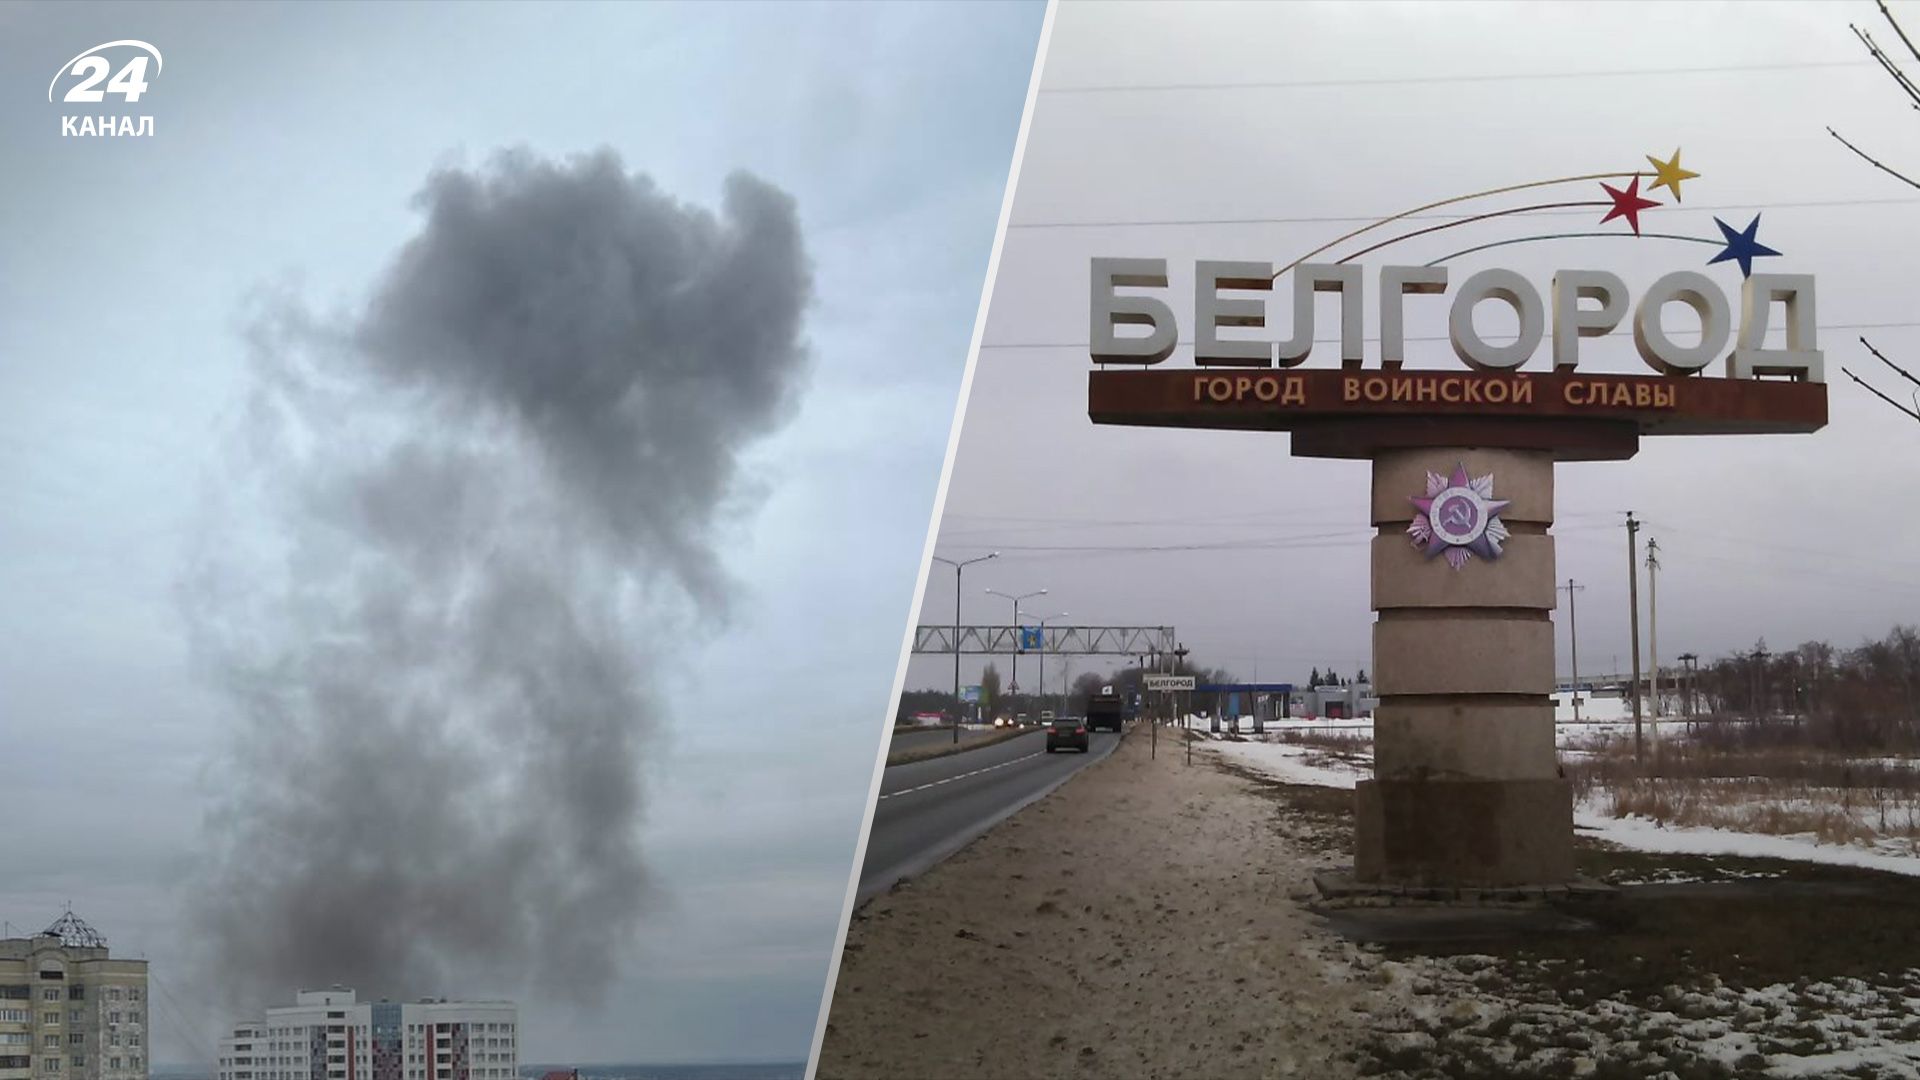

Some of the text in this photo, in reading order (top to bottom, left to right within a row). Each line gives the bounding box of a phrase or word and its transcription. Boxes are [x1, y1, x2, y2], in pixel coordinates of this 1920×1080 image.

[1090, 257, 1824, 383] БЕЛГОРОД
[1194, 374, 1675, 407] ГОРОД ВОИНСКОЙ СЛАВЫ
[1149, 679, 1193, 688] БЕЛГОРОД
